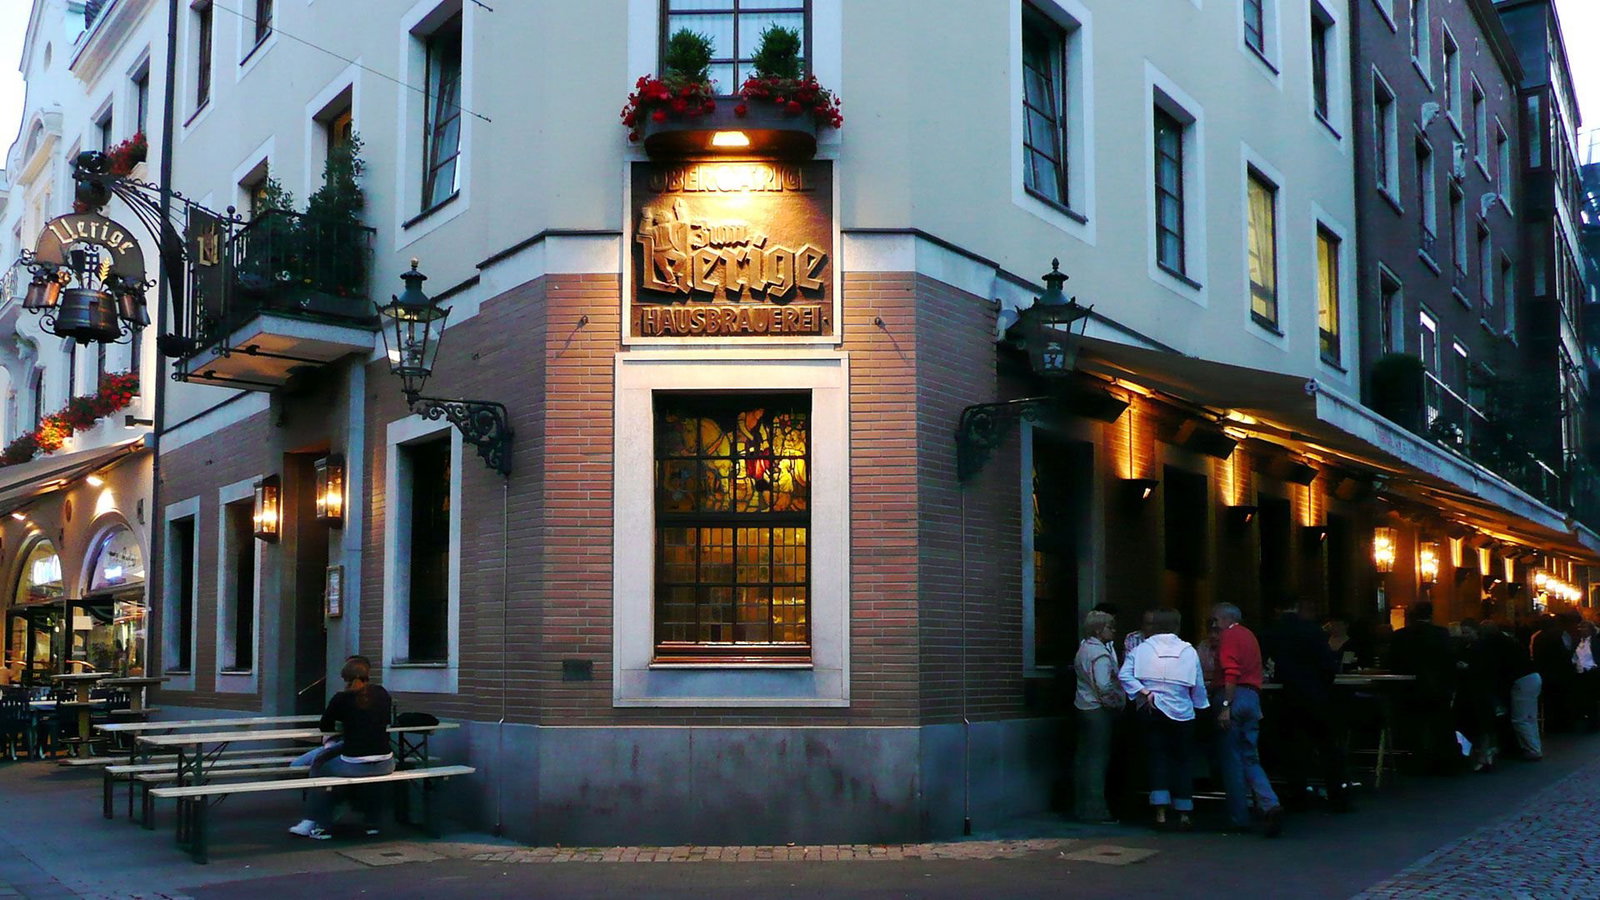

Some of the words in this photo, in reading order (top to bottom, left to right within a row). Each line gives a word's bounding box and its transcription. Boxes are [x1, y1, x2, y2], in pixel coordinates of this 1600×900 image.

[650, 166, 815, 193] OBERRIGE
[48, 218, 135, 255] Uerige
[641, 305, 822, 337] HAUSBRAUEREI
